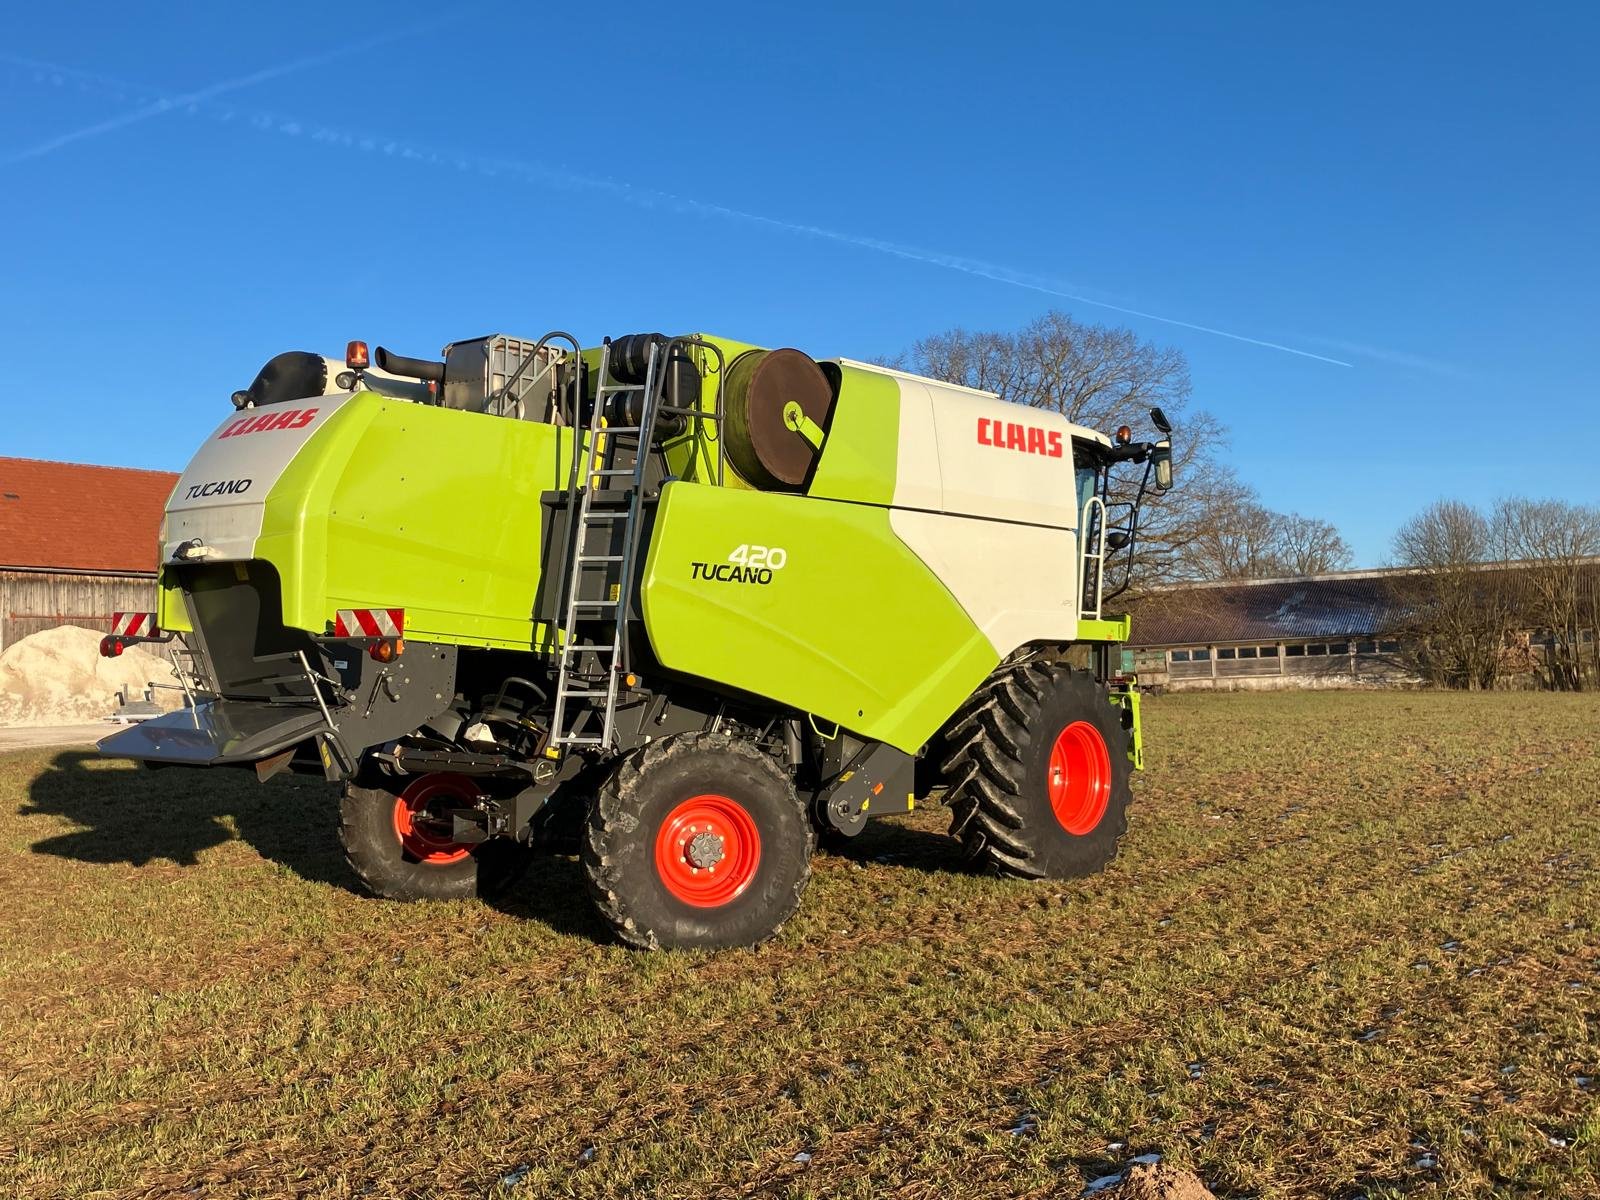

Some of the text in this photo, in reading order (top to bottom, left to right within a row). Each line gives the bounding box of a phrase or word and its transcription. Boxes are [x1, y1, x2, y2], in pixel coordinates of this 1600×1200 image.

[218, 408, 320, 440] CLAAS
[977, 417, 1063, 458] CLAAS
[185, 479, 252, 500] TUCANO
[728, 544, 787, 570] 420
[691, 562, 772, 585] TUCANO
